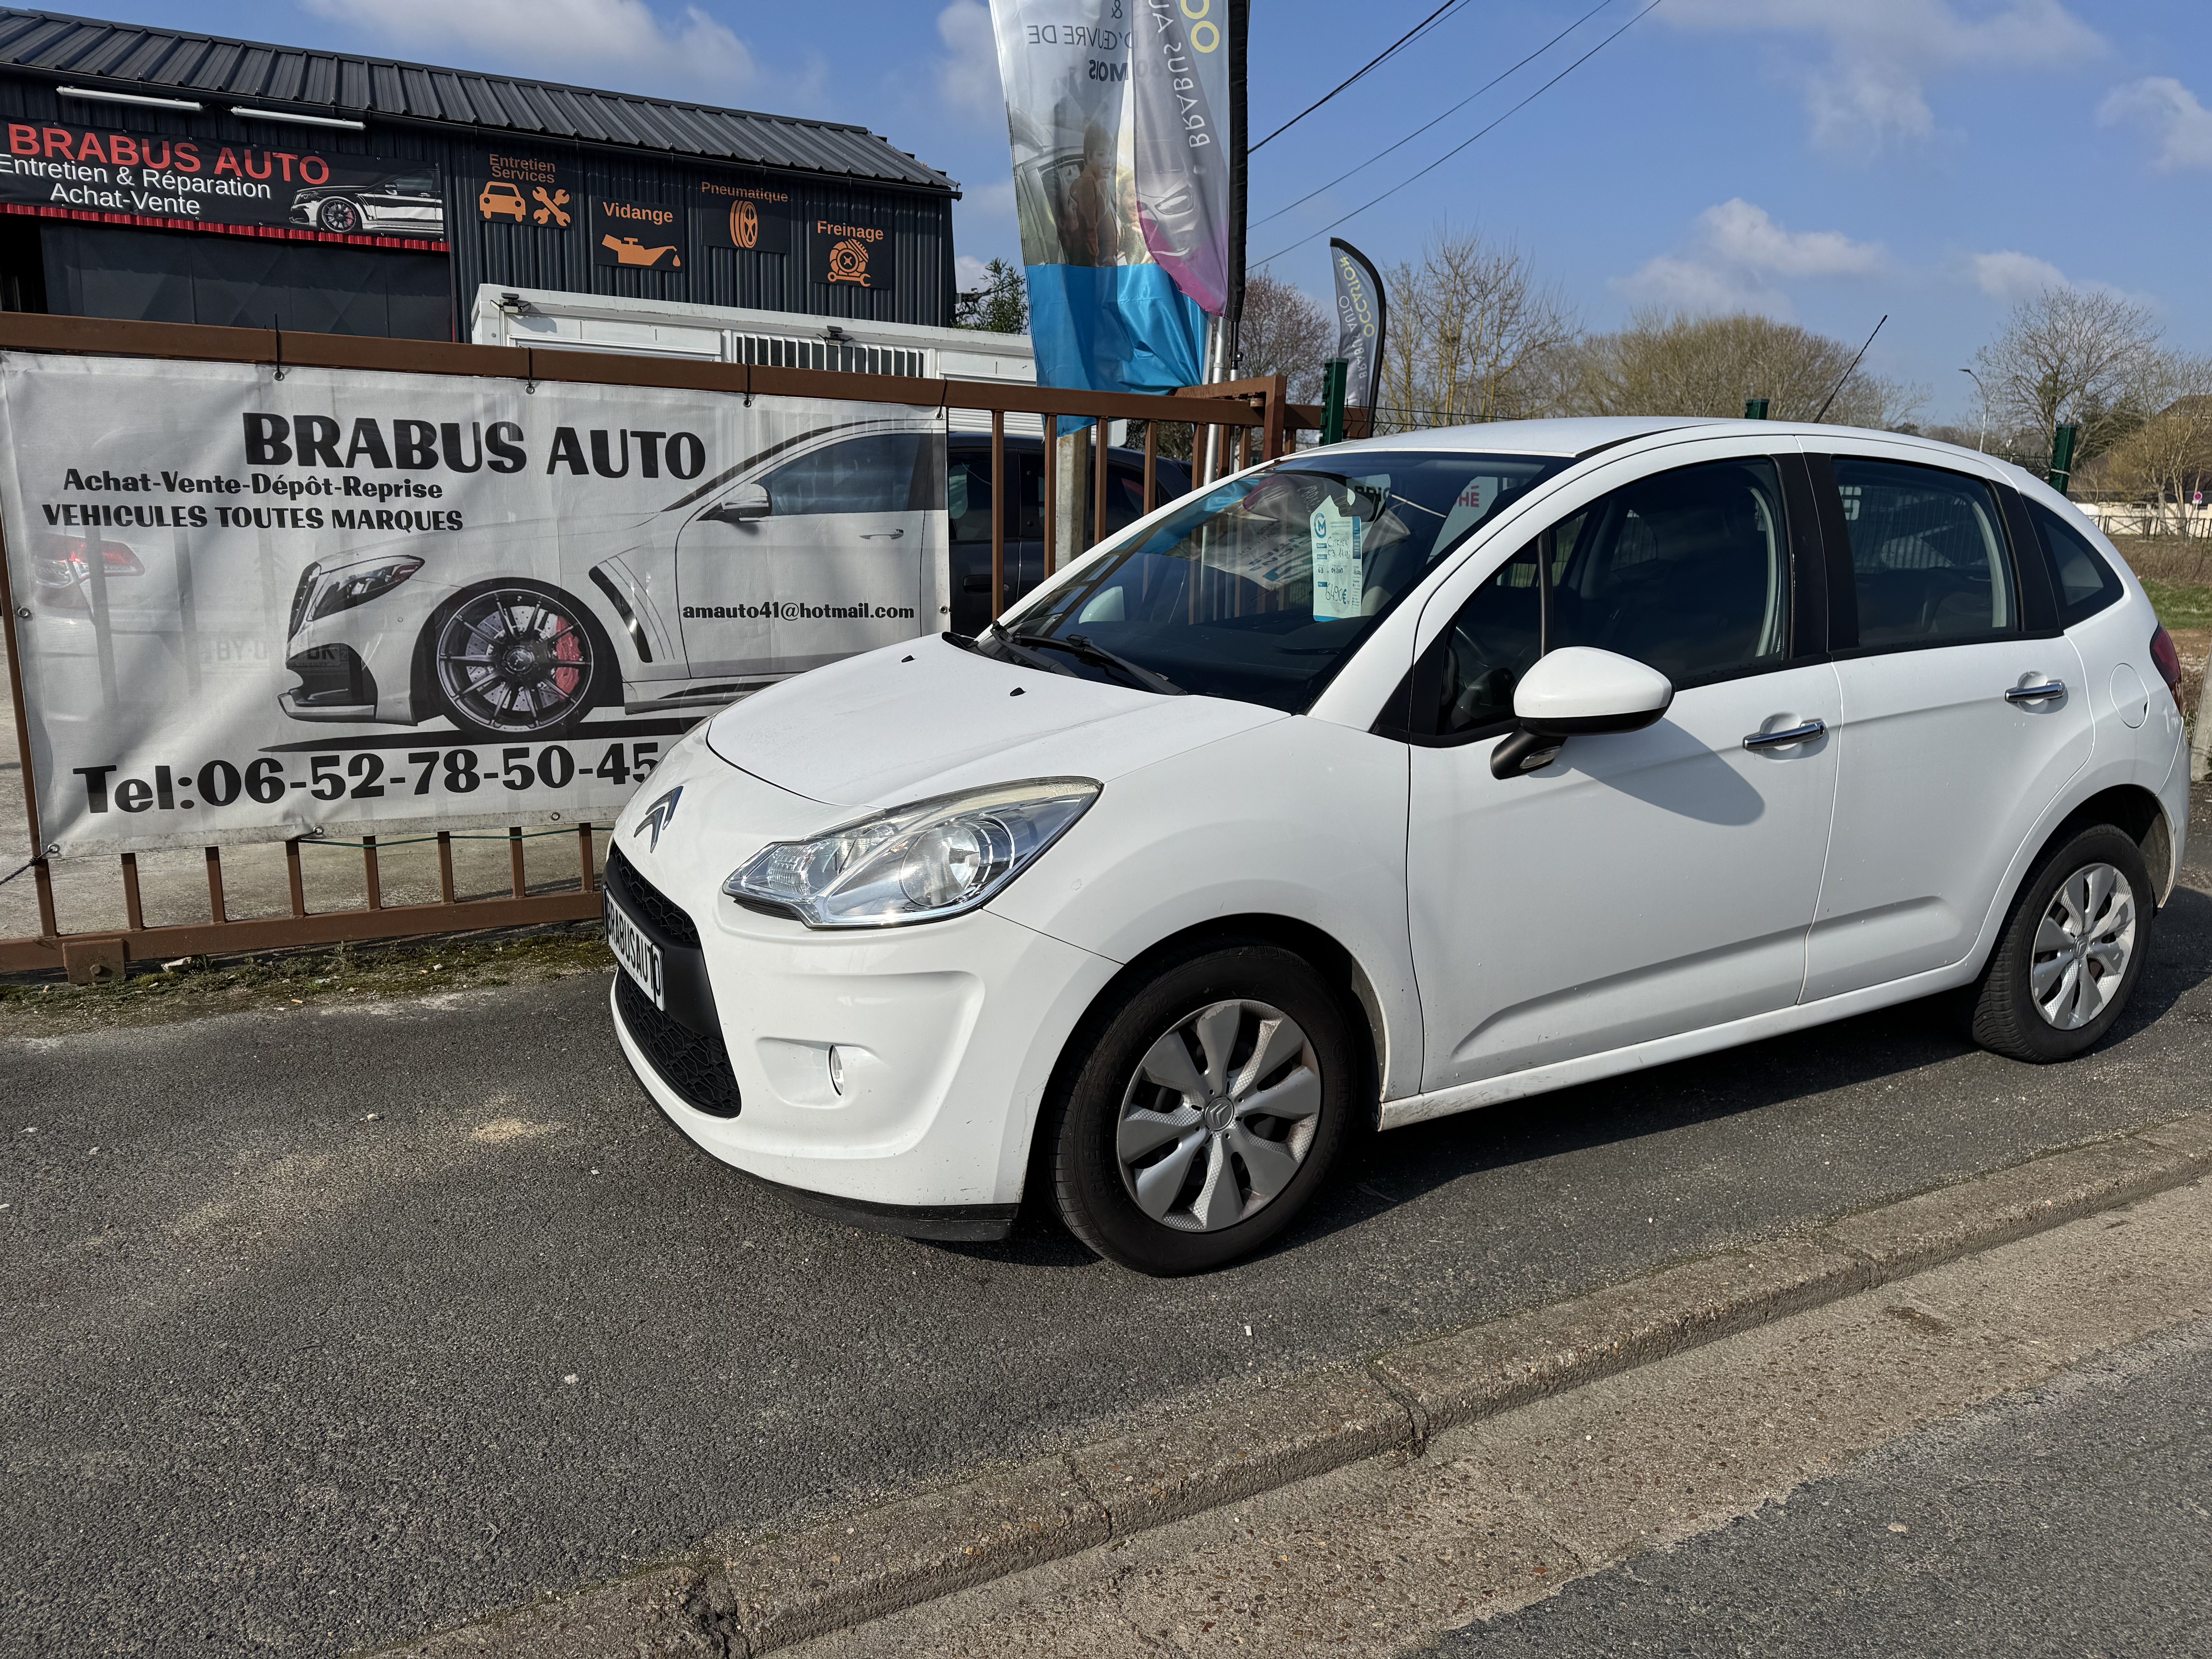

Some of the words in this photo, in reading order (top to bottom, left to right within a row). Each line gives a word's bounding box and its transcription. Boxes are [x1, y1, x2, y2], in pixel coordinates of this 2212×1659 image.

[9, 124, 201, 172] BRABUS
[214, 148, 330, 185] AUTO
[489, 154, 555, 173] Entretien
[0, 153, 108, 184] Entretien
[116, 167, 135, 186] &
[143, 169, 270, 199] Réparation
[491, 165, 555, 184] Services
[50, 183, 200, 215] Achat-Vente
[701, 181, 788, 203] Pneumatique
[603, 202, 673, 225] Vidange
[817, 220, 884, 241] Freinage
[243, 412, 527, 474] BRABUS
[546, 427, 706, 480] AUTO
[64, 469, 443, 500] Achat-Vente-Dépôt-Reprise
[42, 504, 208, 527] VEHICULES
[215, 507, 324, 529] TOUTES
[332, 509, 463, 533] MARQUES
[683, 601, 914, 621] amauto41@hotmail.com
[72, 742, 659, 814] Tel:06-52-78-50-45
[606, 896, 661, 997] BRABUSAUTO
